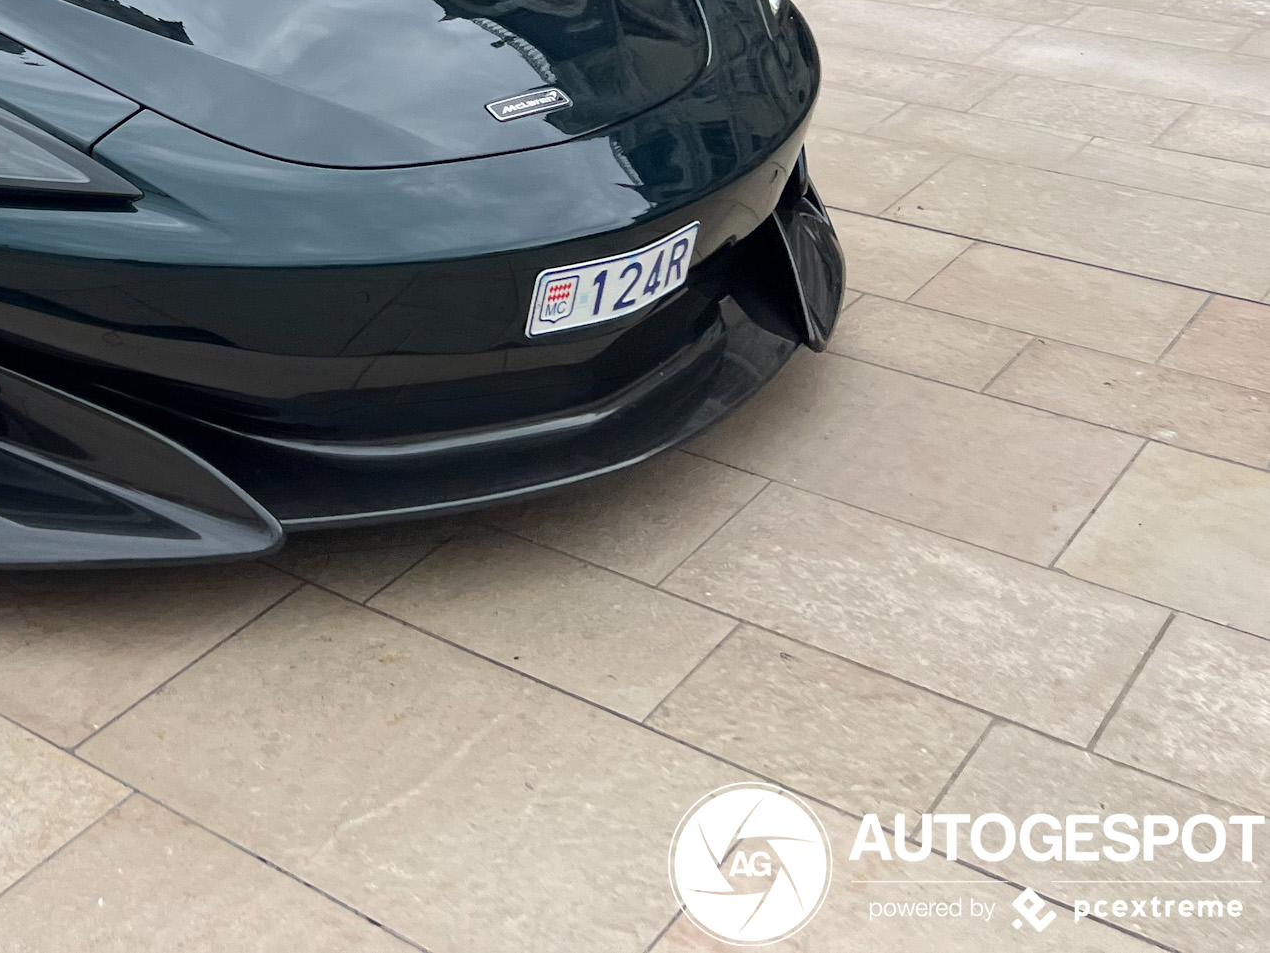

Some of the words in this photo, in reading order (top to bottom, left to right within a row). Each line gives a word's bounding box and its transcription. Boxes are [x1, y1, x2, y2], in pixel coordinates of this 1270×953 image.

[502, 95, 556, 115] McLaren
[592, 237, 689, 316] 124R
[545, 300, 567, 317] MC
